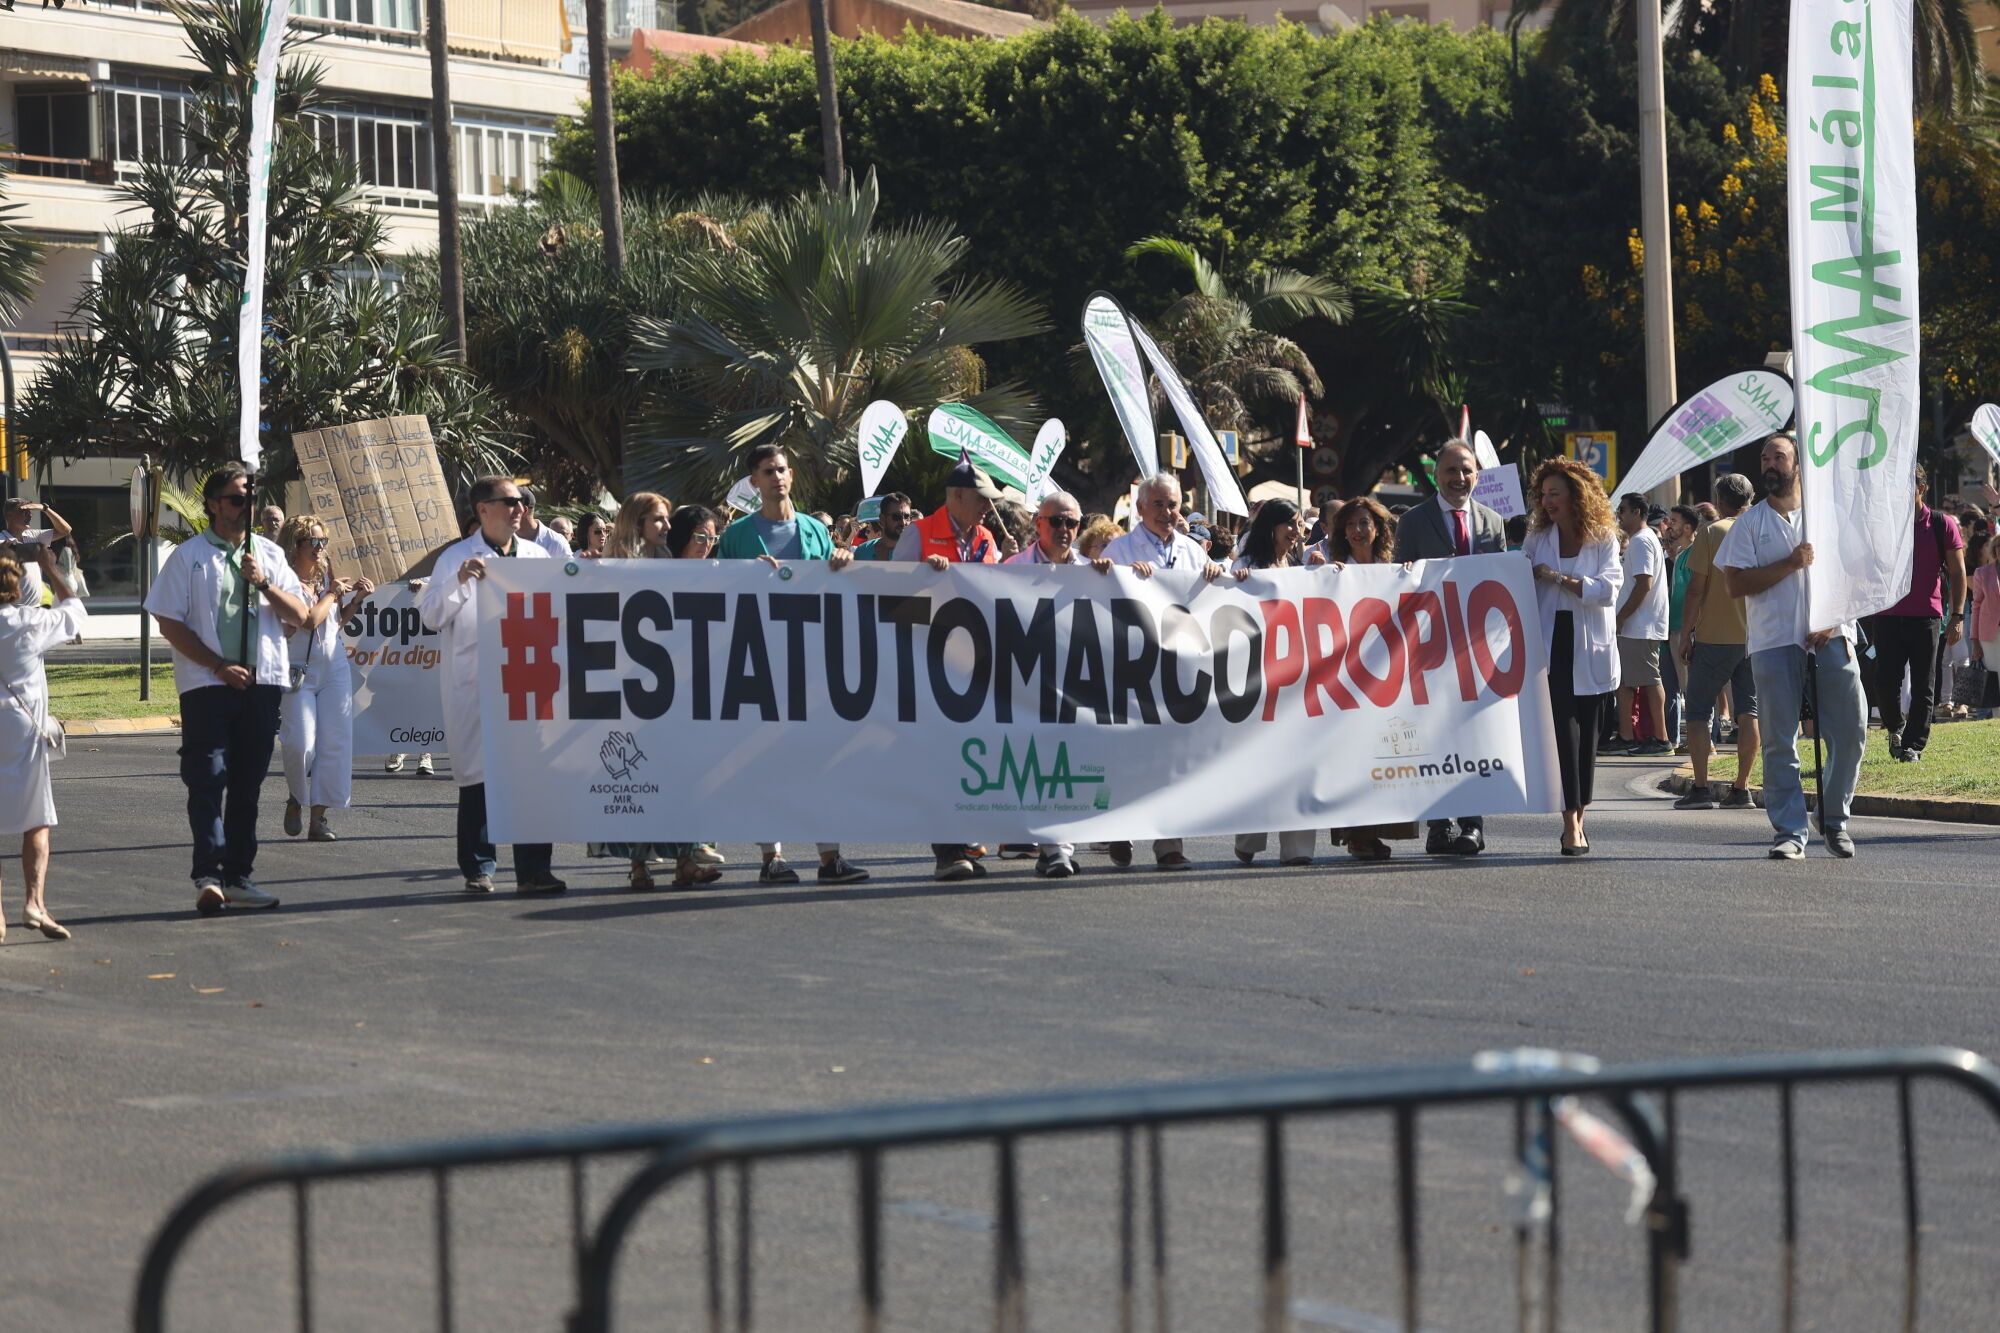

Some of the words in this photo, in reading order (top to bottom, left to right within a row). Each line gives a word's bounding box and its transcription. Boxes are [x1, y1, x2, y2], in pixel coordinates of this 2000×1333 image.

[1802, 249, 1912, 470] SMA
[1738, 374, 1782, 423] SMA
[396, 420, 428, 440] Verde
[943, 418, 982, 452] SMA
[863, 420, 897, 469] SMA
[349, 447, 431, 476] CANSADA
[1029, 438, 1059, 490] SMA
[316, 494, 335, 509] DE
[416, 498, 439, 522] 60
[337, 544, 380, 562] HORAS
[381, 645, 401, 666] la
[500, 579, 1526, 722] #ESTATUTOMARCOPROPIO
[390, 726, 445, 746] Colegio
[960, 733, 1076, 805] SMA
[1080, 763, 1106, 774] Málaga
[1371, 753, 1504, 781] commálaga
[589, 782, 659, 794] ASOCIACIÓN
[603, 804, 644, 814] ESPAÑA
[613, 795, 642, 804] MIR
[955, 803, 989, 812] Sindicato
